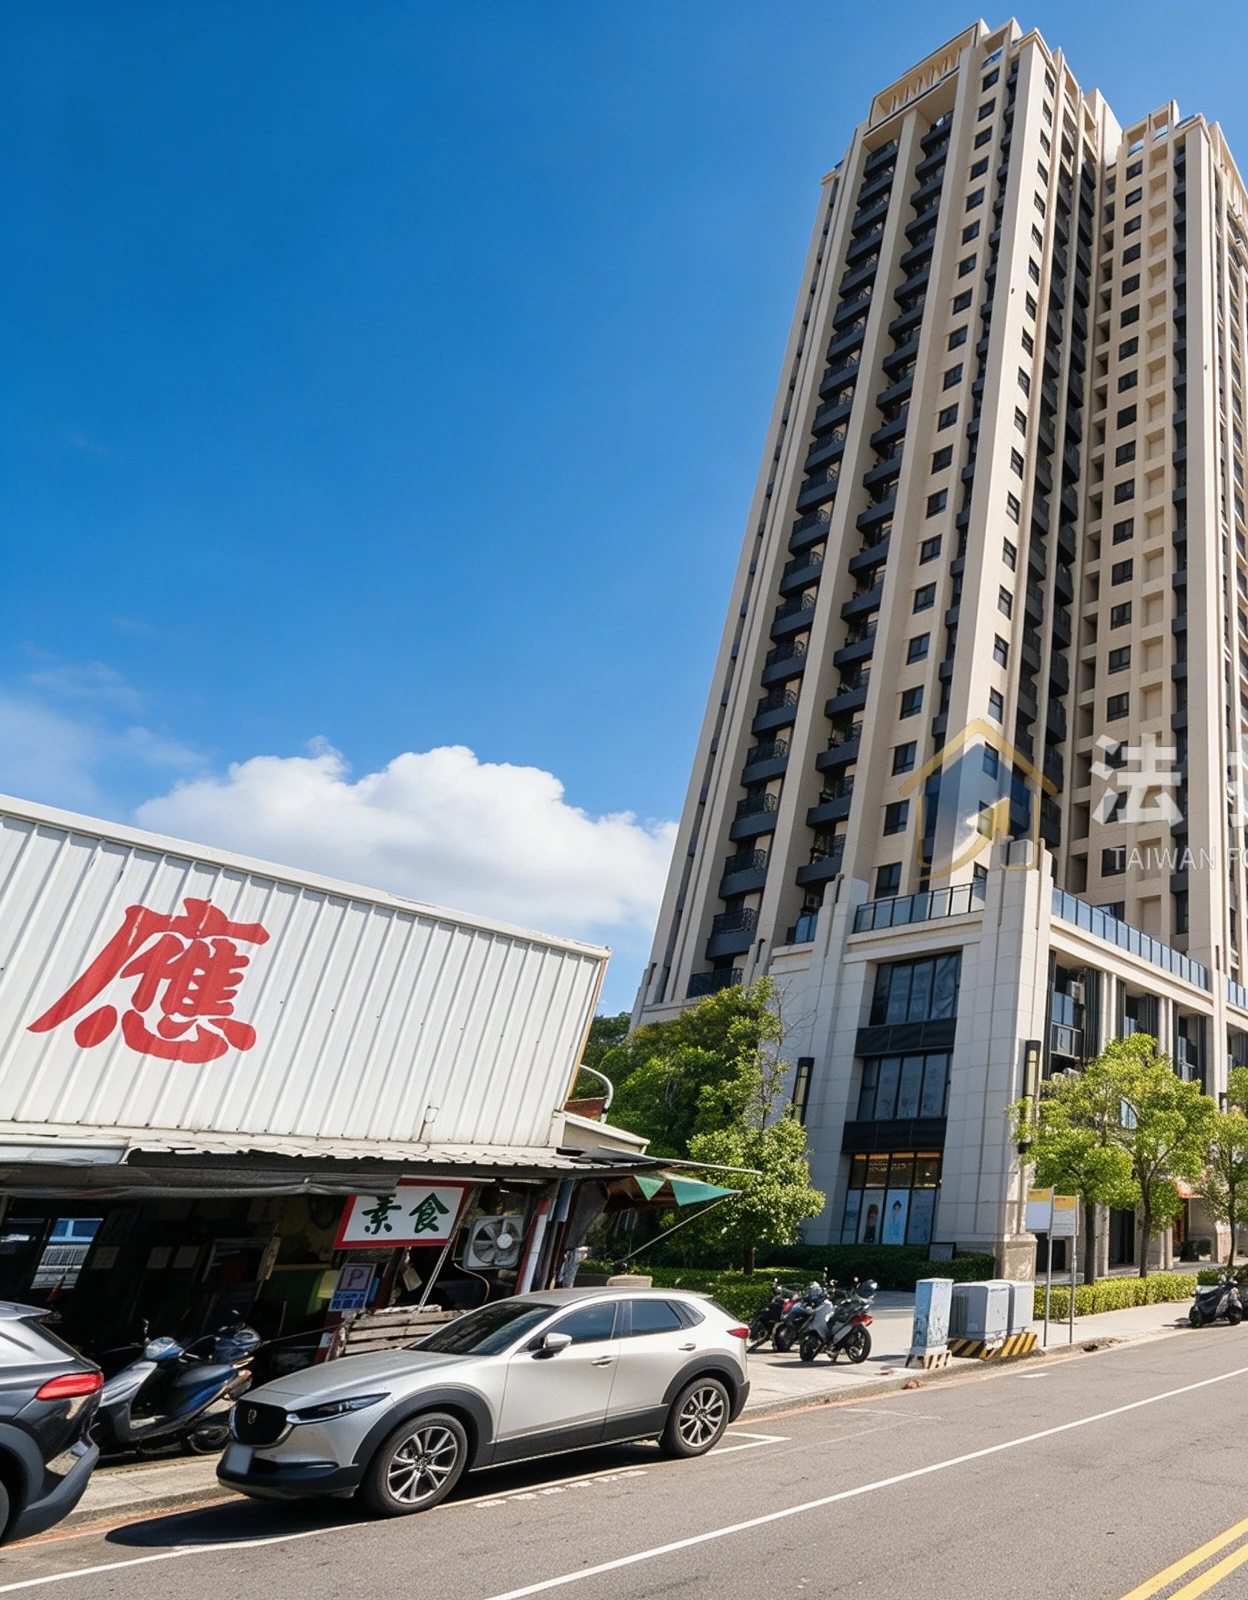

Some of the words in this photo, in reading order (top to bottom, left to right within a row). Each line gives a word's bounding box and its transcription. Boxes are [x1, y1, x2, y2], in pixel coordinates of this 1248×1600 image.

[26, 897, 270, 1064] 應
[362, 1192, 450, 1235] 素食
[347, 1268, 364, 1288] P
